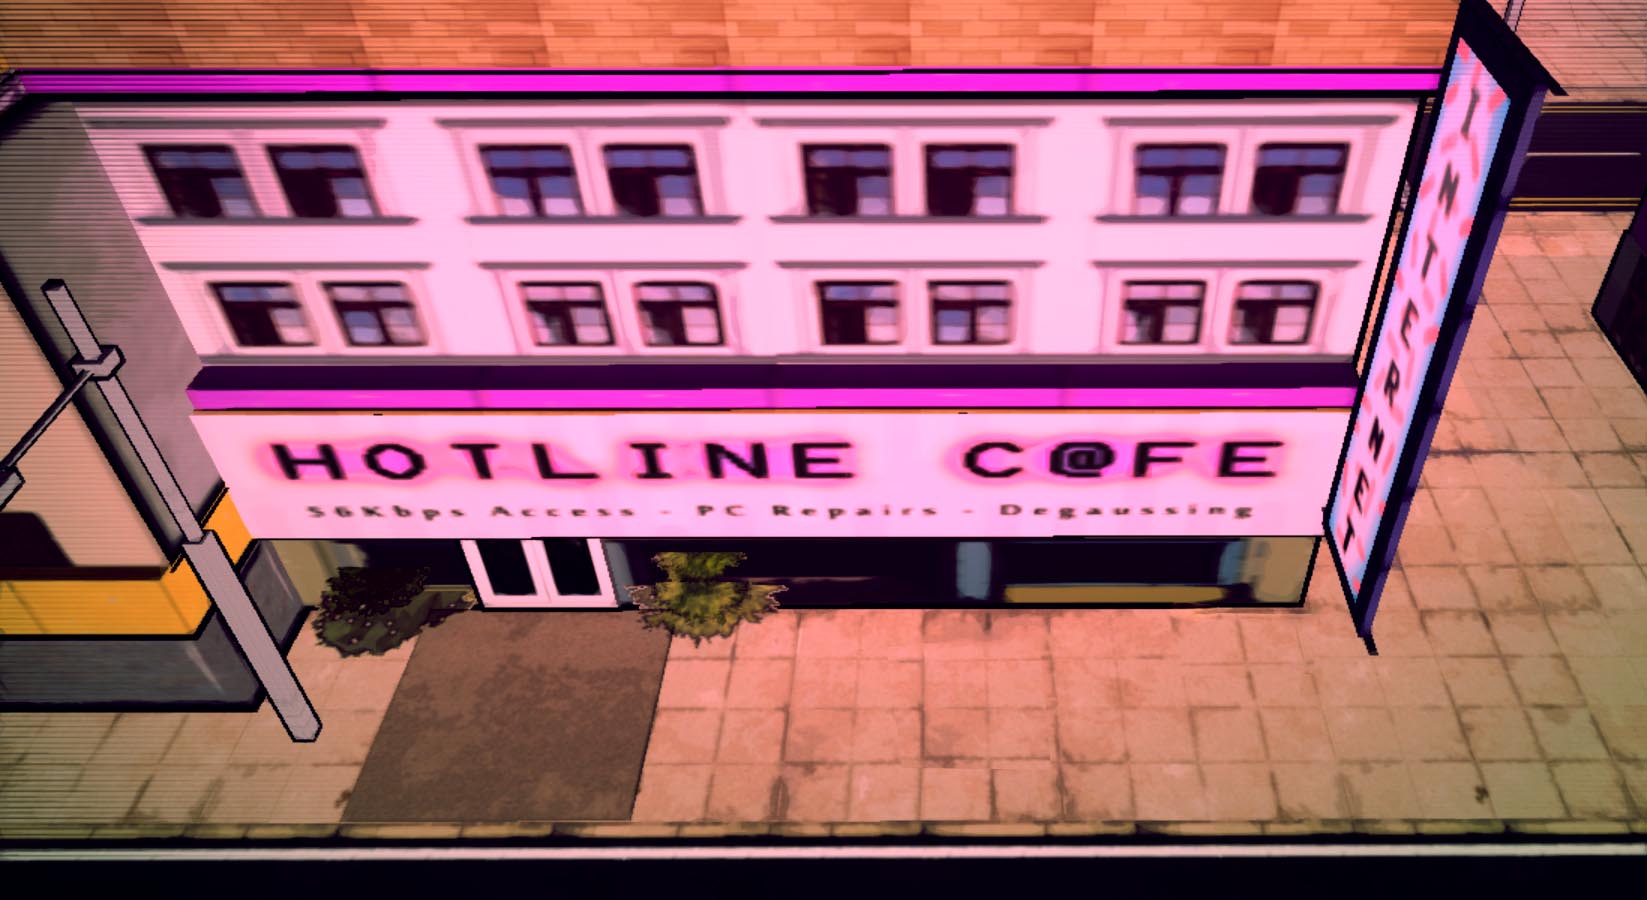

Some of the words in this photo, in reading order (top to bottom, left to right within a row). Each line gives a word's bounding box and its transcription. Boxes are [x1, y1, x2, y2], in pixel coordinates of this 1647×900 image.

[1342, 87, 1480, 555] INTERNET
[271, 442, 855, 481] HOTLINE
[964, 441, 1283, 479] C@FE
[307, 505, 465, 521] 56Kbps
[491, 505, 636, 517] Access
[697, 505, 746, 517] PC
[771, 505, 938, 519] Repairs
[1000, 504, 1253, 519] Degaussing
